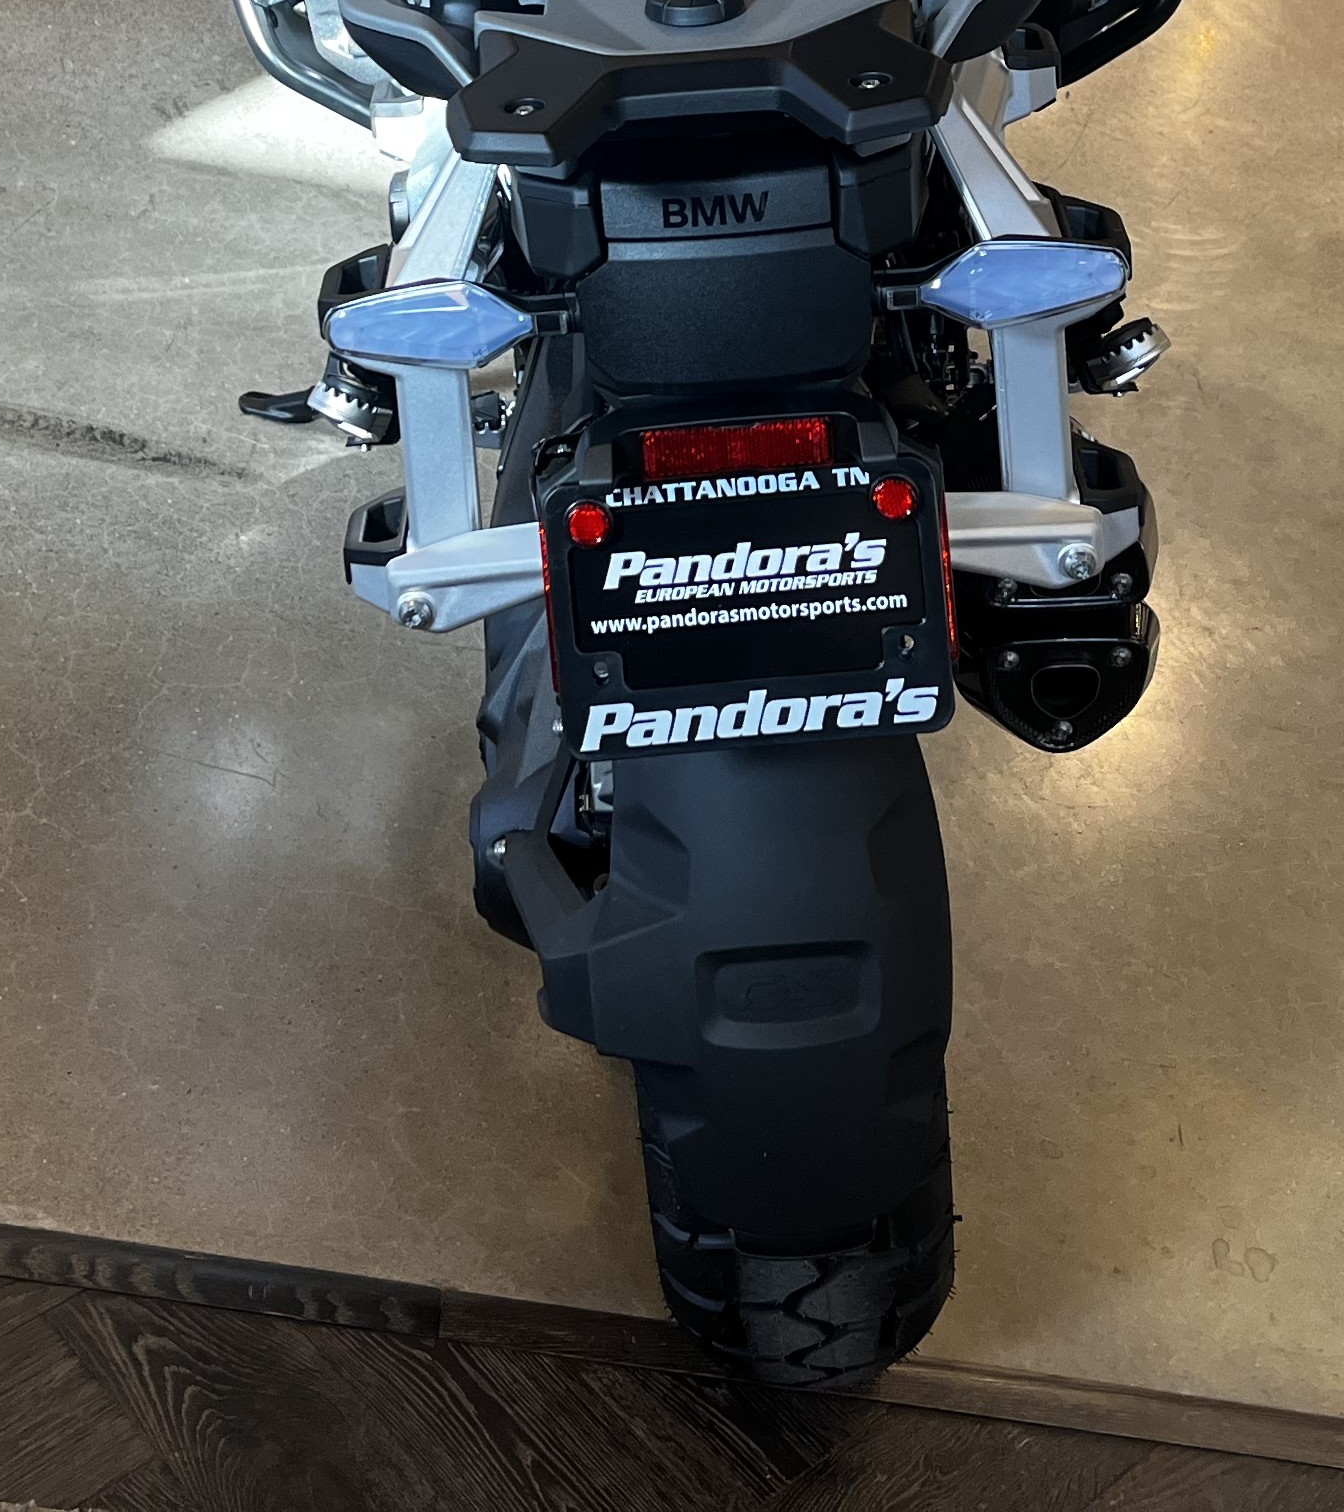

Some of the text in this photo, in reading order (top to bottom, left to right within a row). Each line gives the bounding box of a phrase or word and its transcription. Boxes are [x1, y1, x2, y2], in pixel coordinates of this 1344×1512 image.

[662, 190, 769, 229] BMW
[606, 466, 870, 508] CHATTANOOGA TN
[603, 531, 887, 590] Pandora's
[634, 569, 878, 604] EUROPEAN MOTORSPORTS
[590, 593, 909, 635] www.pandorasmotorsports.com
[579, 677, 939, 753] Pandora's
